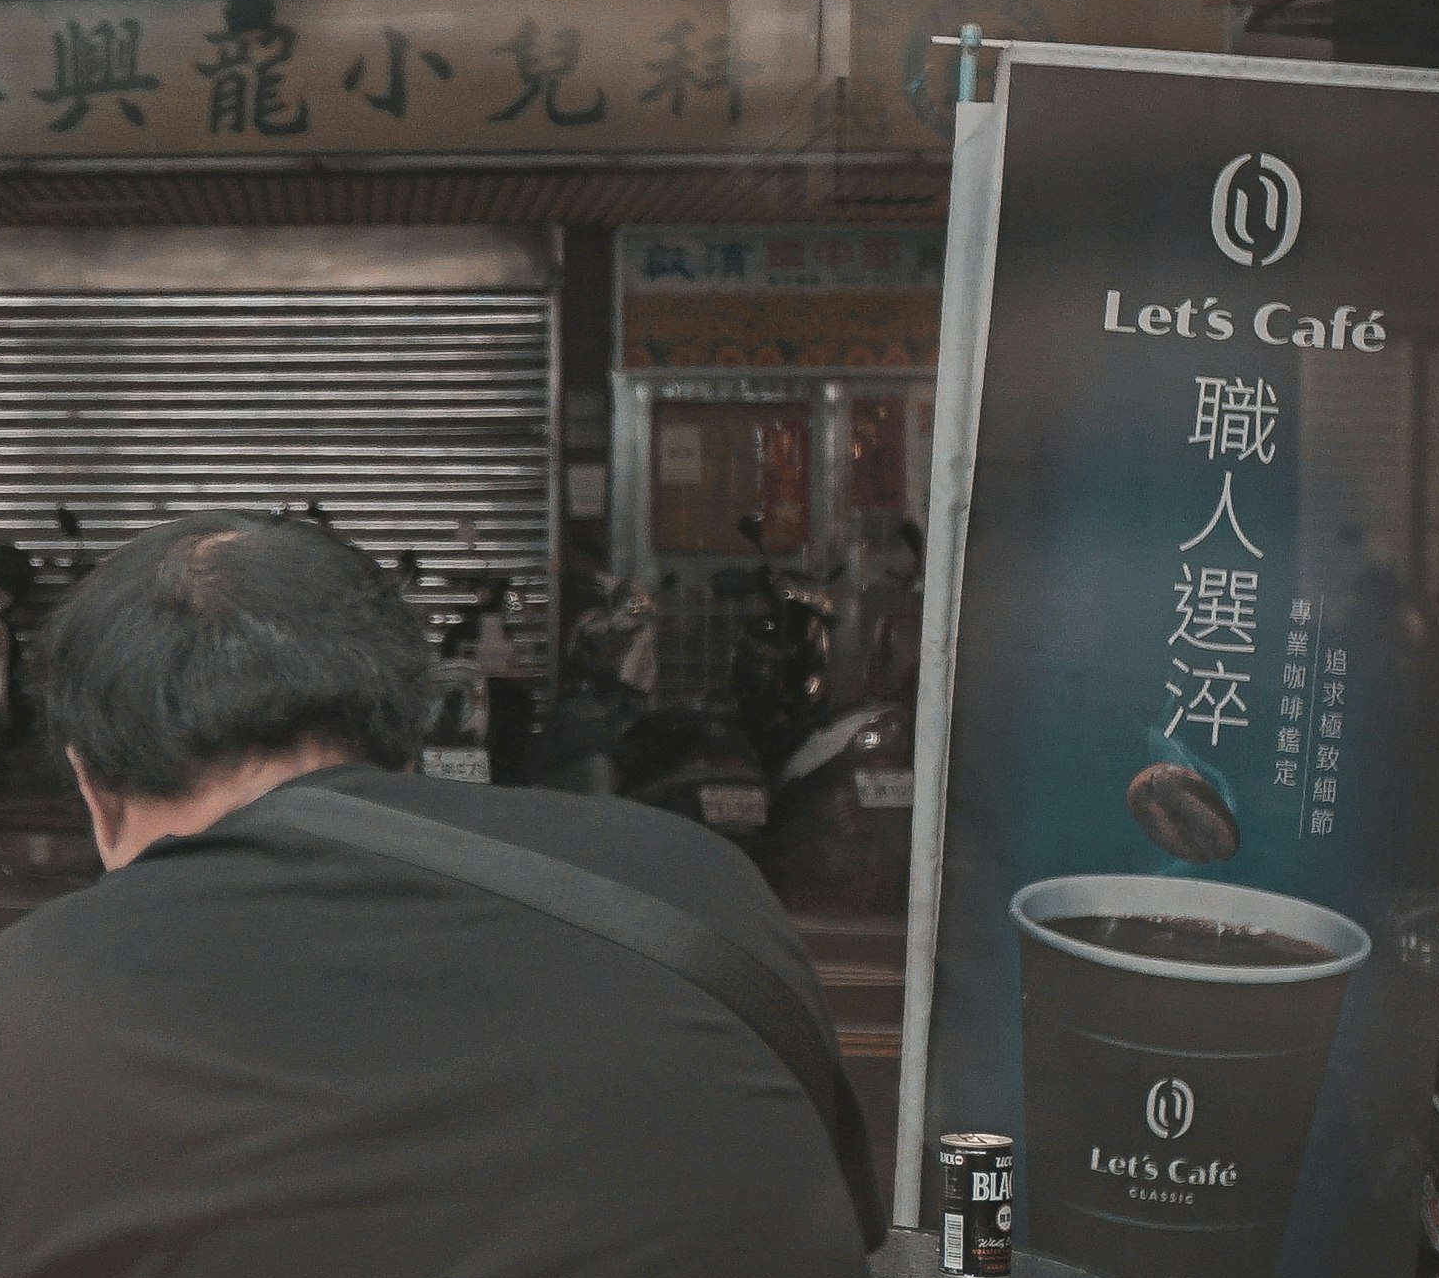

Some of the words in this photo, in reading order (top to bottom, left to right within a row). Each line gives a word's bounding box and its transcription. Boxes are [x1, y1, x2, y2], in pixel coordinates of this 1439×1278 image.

[1104, 290, 1234, 341] Let's
[1253, 302, 1387, 353] Café
[1163, 375, 1280, 749] 職人選淬
[1273, 599, 1312, 787] 專業咖啡鑑定
[1309, 647, 1348, 836] 追求極致細節
[1089, 1146, 1159, 1181] Let's
[1167, 1157, 1238, 1187] Café
[1127, 1186, 1195, 1205] CLASSIC
